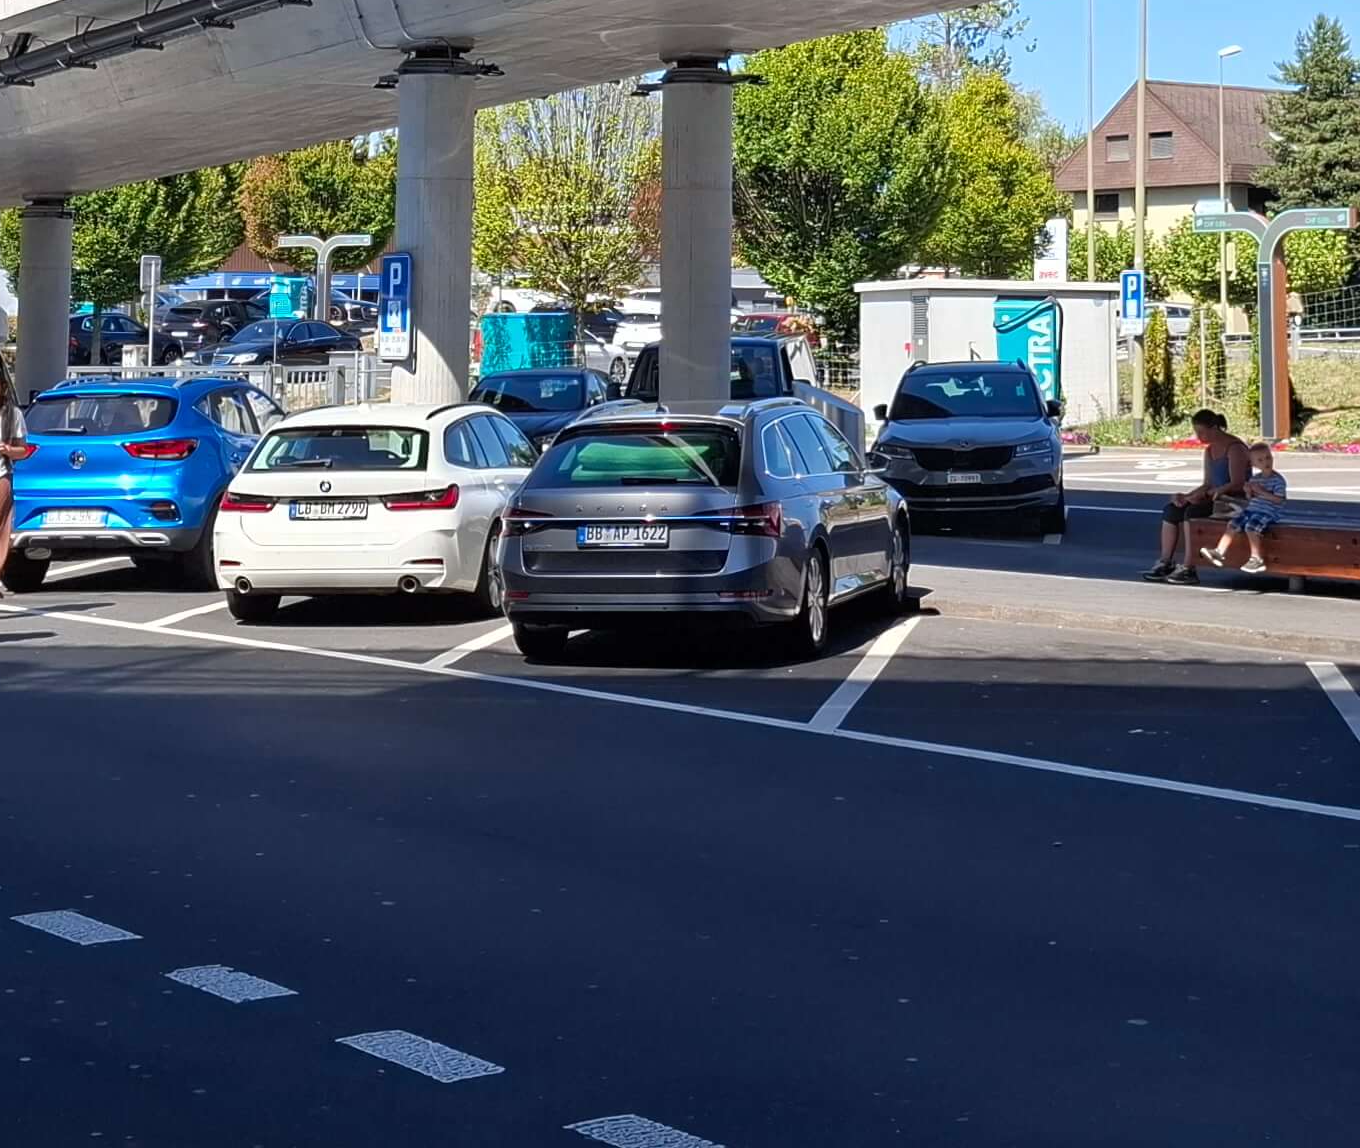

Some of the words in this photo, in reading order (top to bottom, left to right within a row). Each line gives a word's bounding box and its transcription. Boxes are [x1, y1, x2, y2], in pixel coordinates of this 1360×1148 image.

[390, 262, 402, 301] P
[1039, 271, 1058, 280] avec
[1127, 275, 1137, 299] P
[586, 526, 603, 541] BB
[613, 526, 630, 541] AP
[633, 526, 666, 541] 1622
